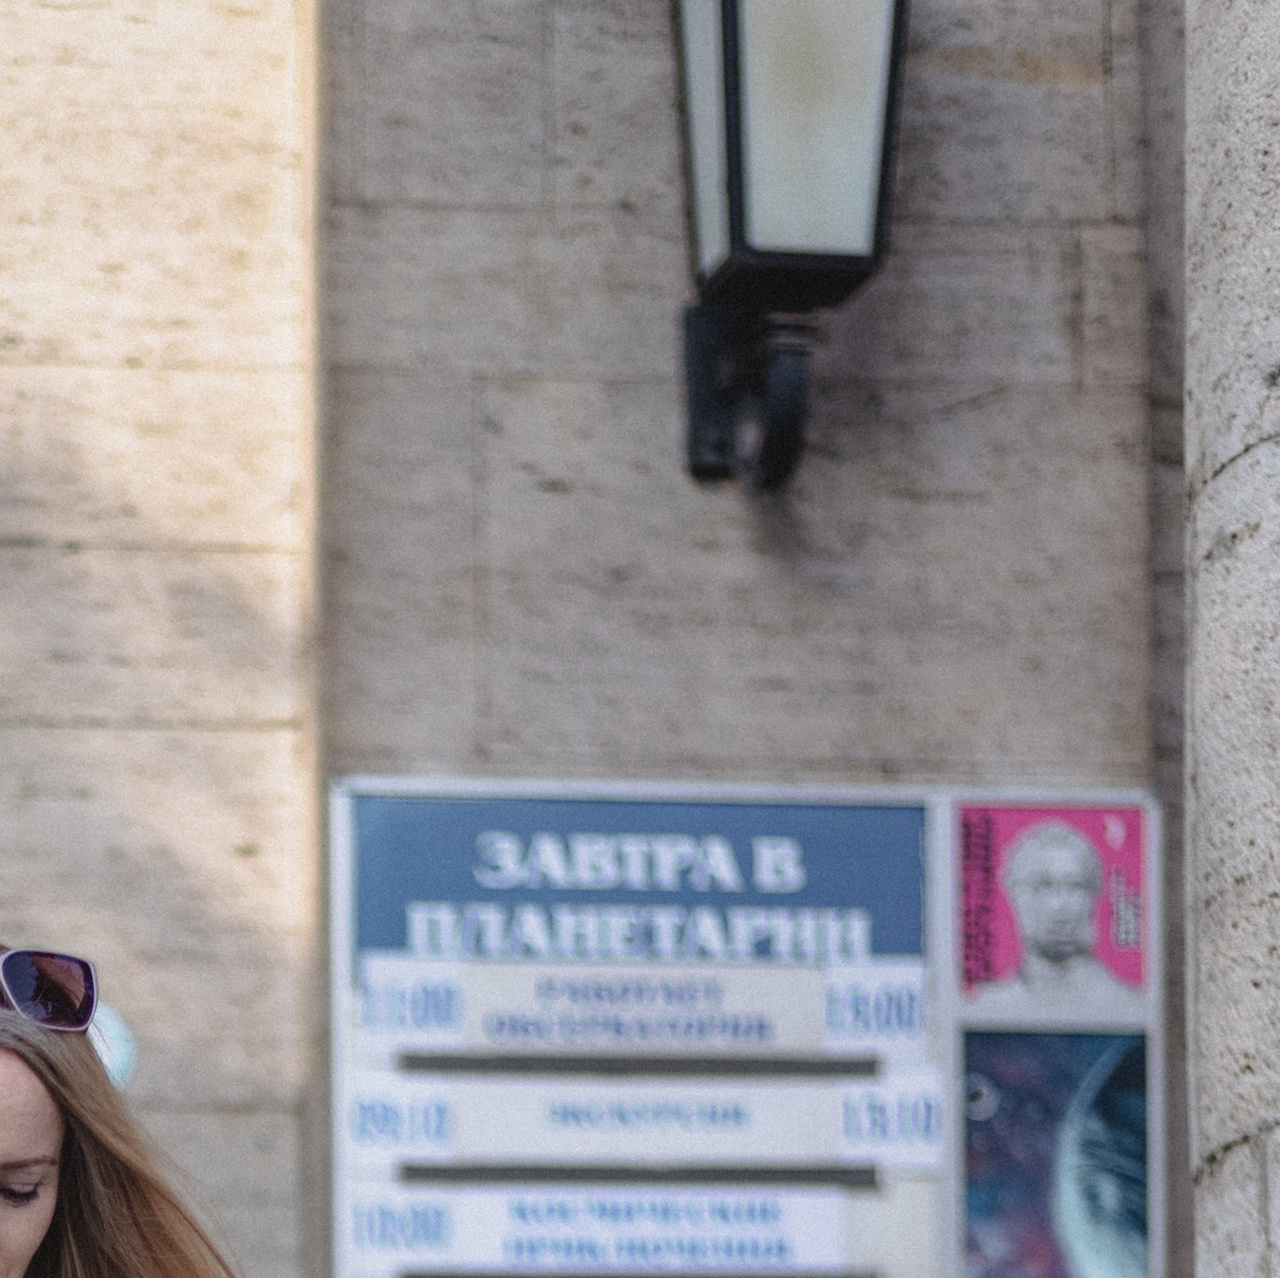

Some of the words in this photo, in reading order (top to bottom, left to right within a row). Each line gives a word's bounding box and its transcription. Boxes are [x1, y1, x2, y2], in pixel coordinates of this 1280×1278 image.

[472, 830, 739, 893] ЗАВТРА
[752, 833, 807, 894] В
[406, 901, 873, 960] ПЛАНЕТАРИИ
